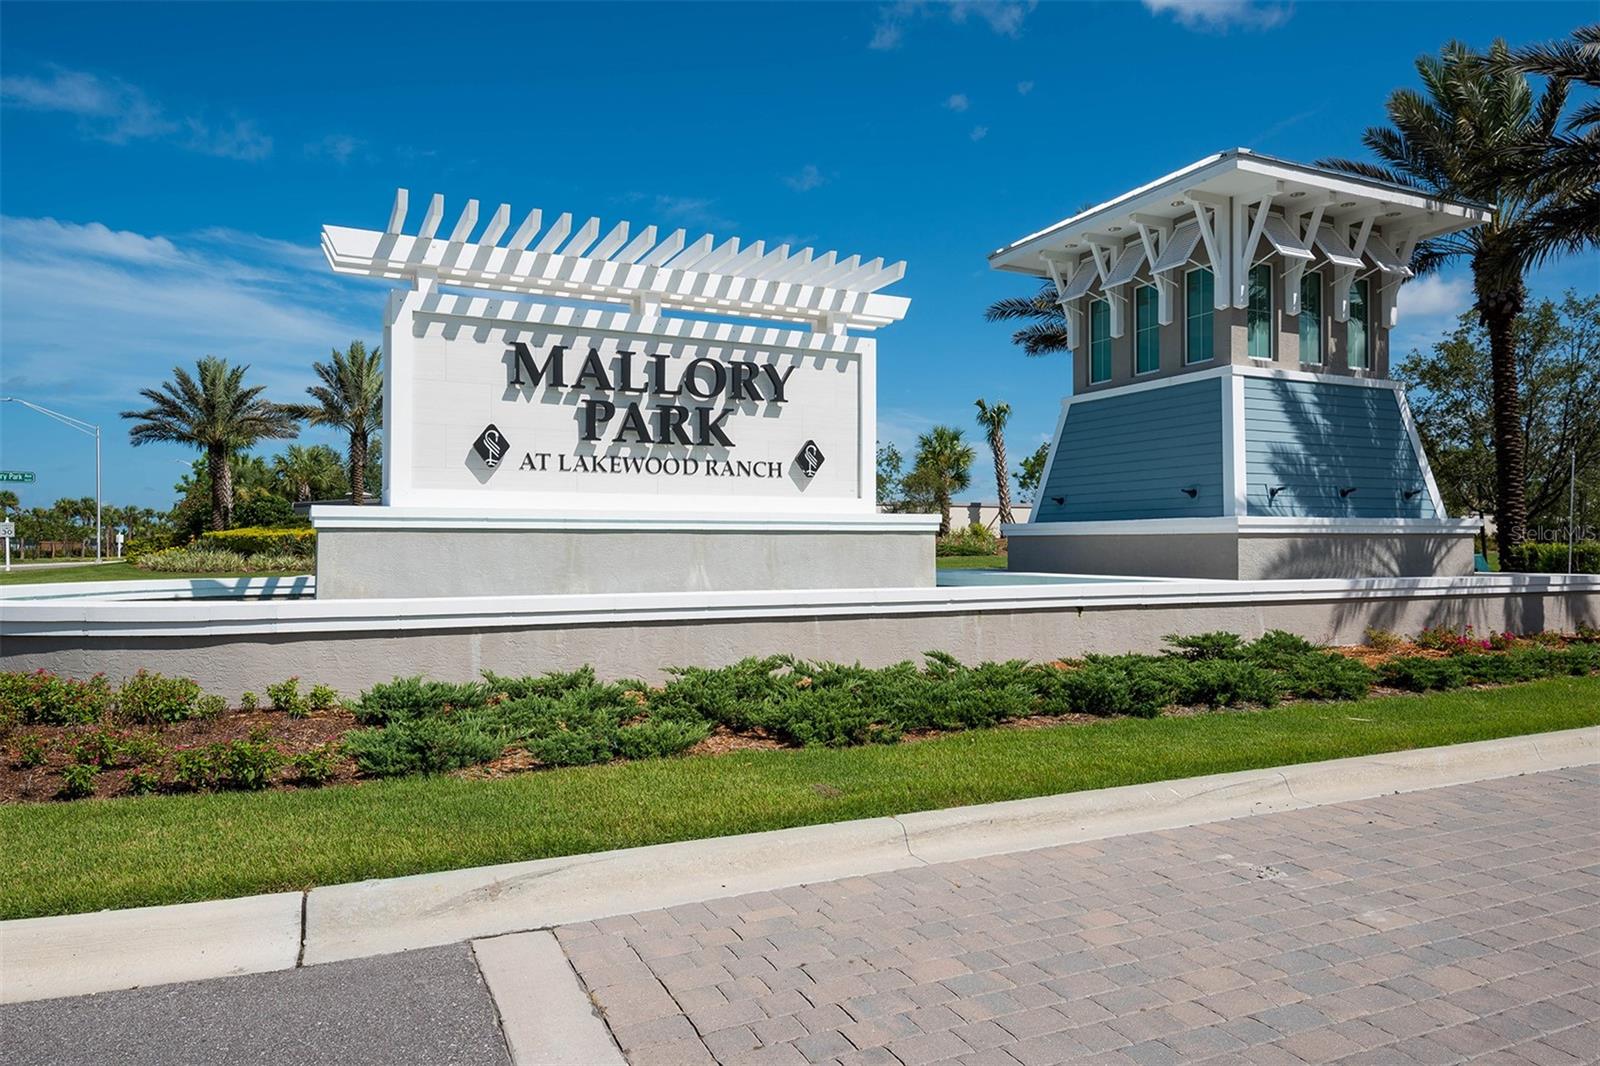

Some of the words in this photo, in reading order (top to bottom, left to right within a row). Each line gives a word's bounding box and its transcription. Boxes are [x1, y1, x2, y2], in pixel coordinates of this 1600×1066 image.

[508, 341, 796, 404] MALLORY
[581, 399, 735, 447] PARK
[9, 472, 23, 480] Park
[519, 452, 551, 472] AT
[558, 453, 698, 476] LAKEWOOD
[705, 460, 783, 478] RANCH
